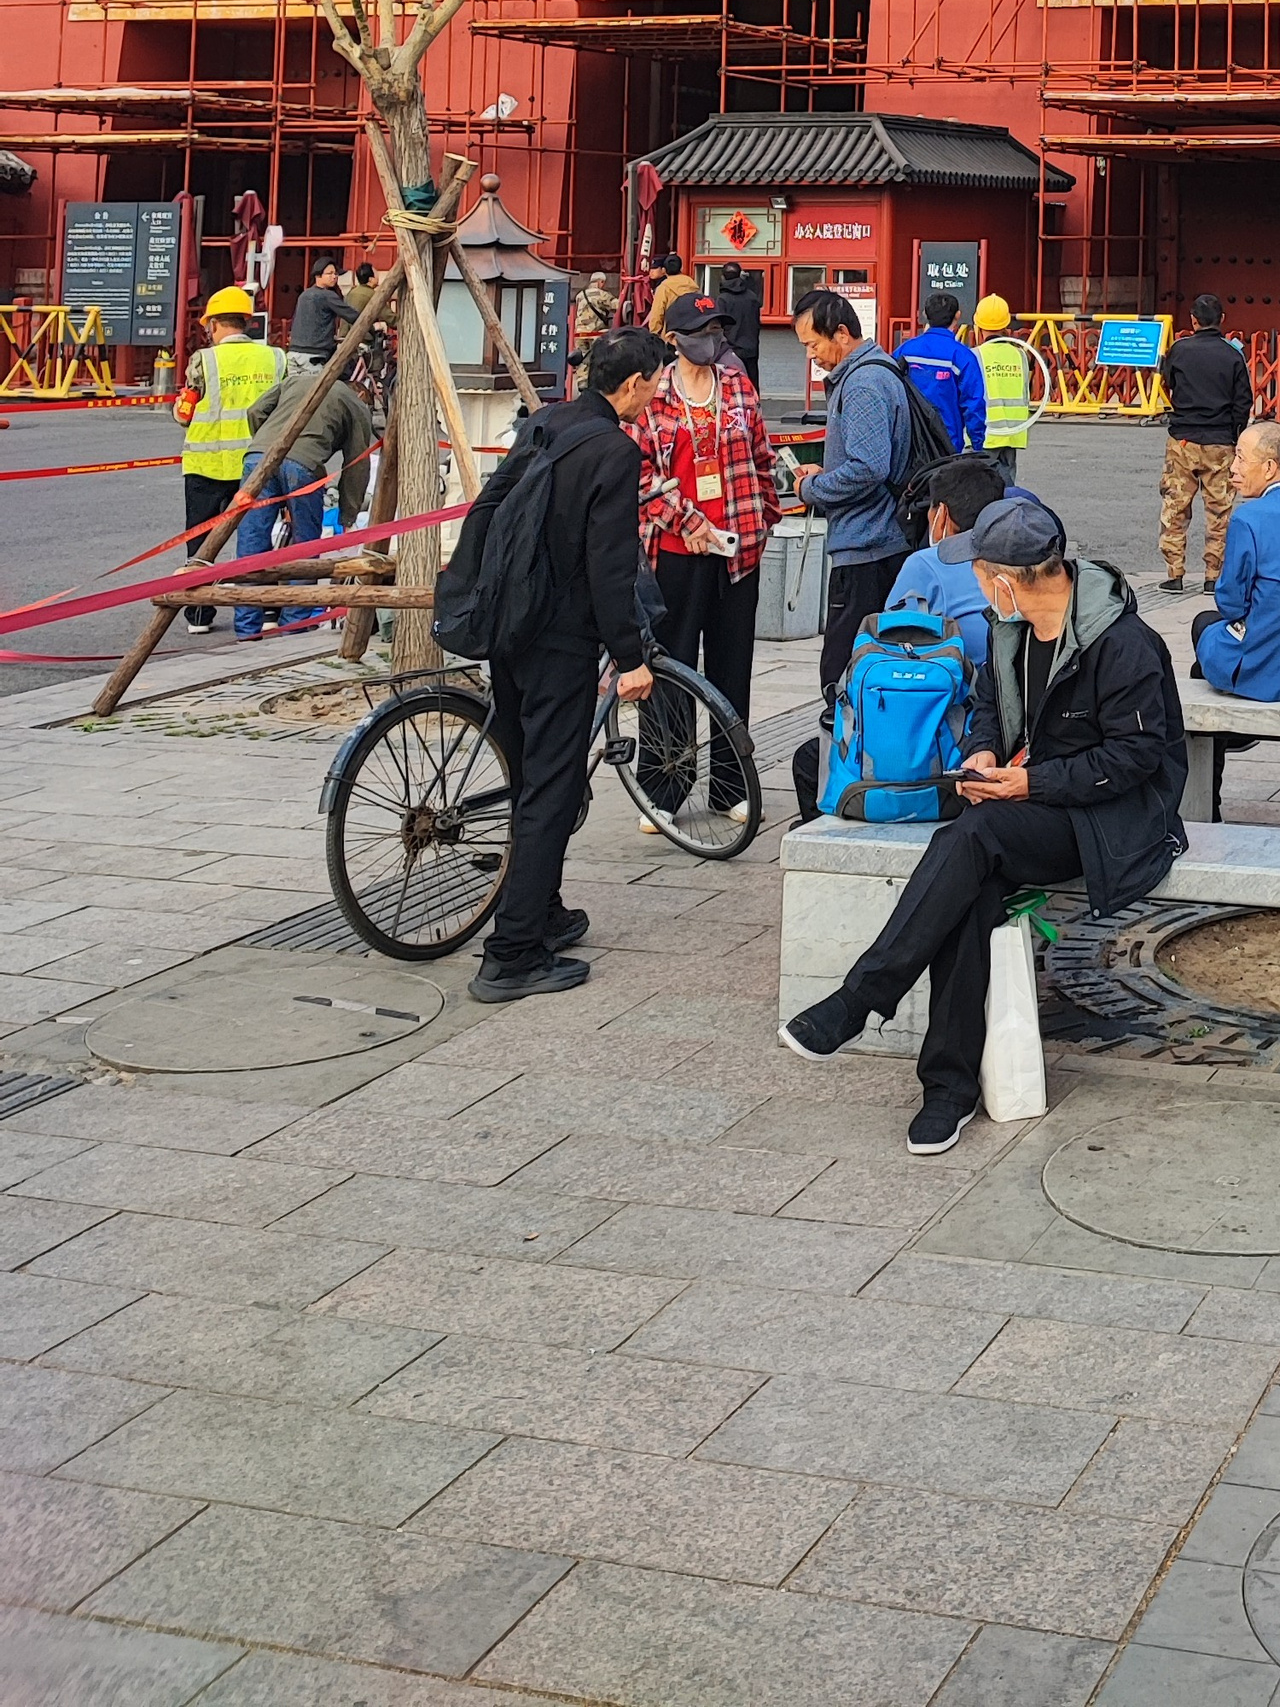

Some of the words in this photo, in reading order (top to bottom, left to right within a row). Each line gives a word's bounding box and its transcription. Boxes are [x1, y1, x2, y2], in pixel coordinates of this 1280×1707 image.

[926, 262, 970, 278] 取包处
[931, 280, 944, 290] Bag
[944, 280, 965, 288] Claim
